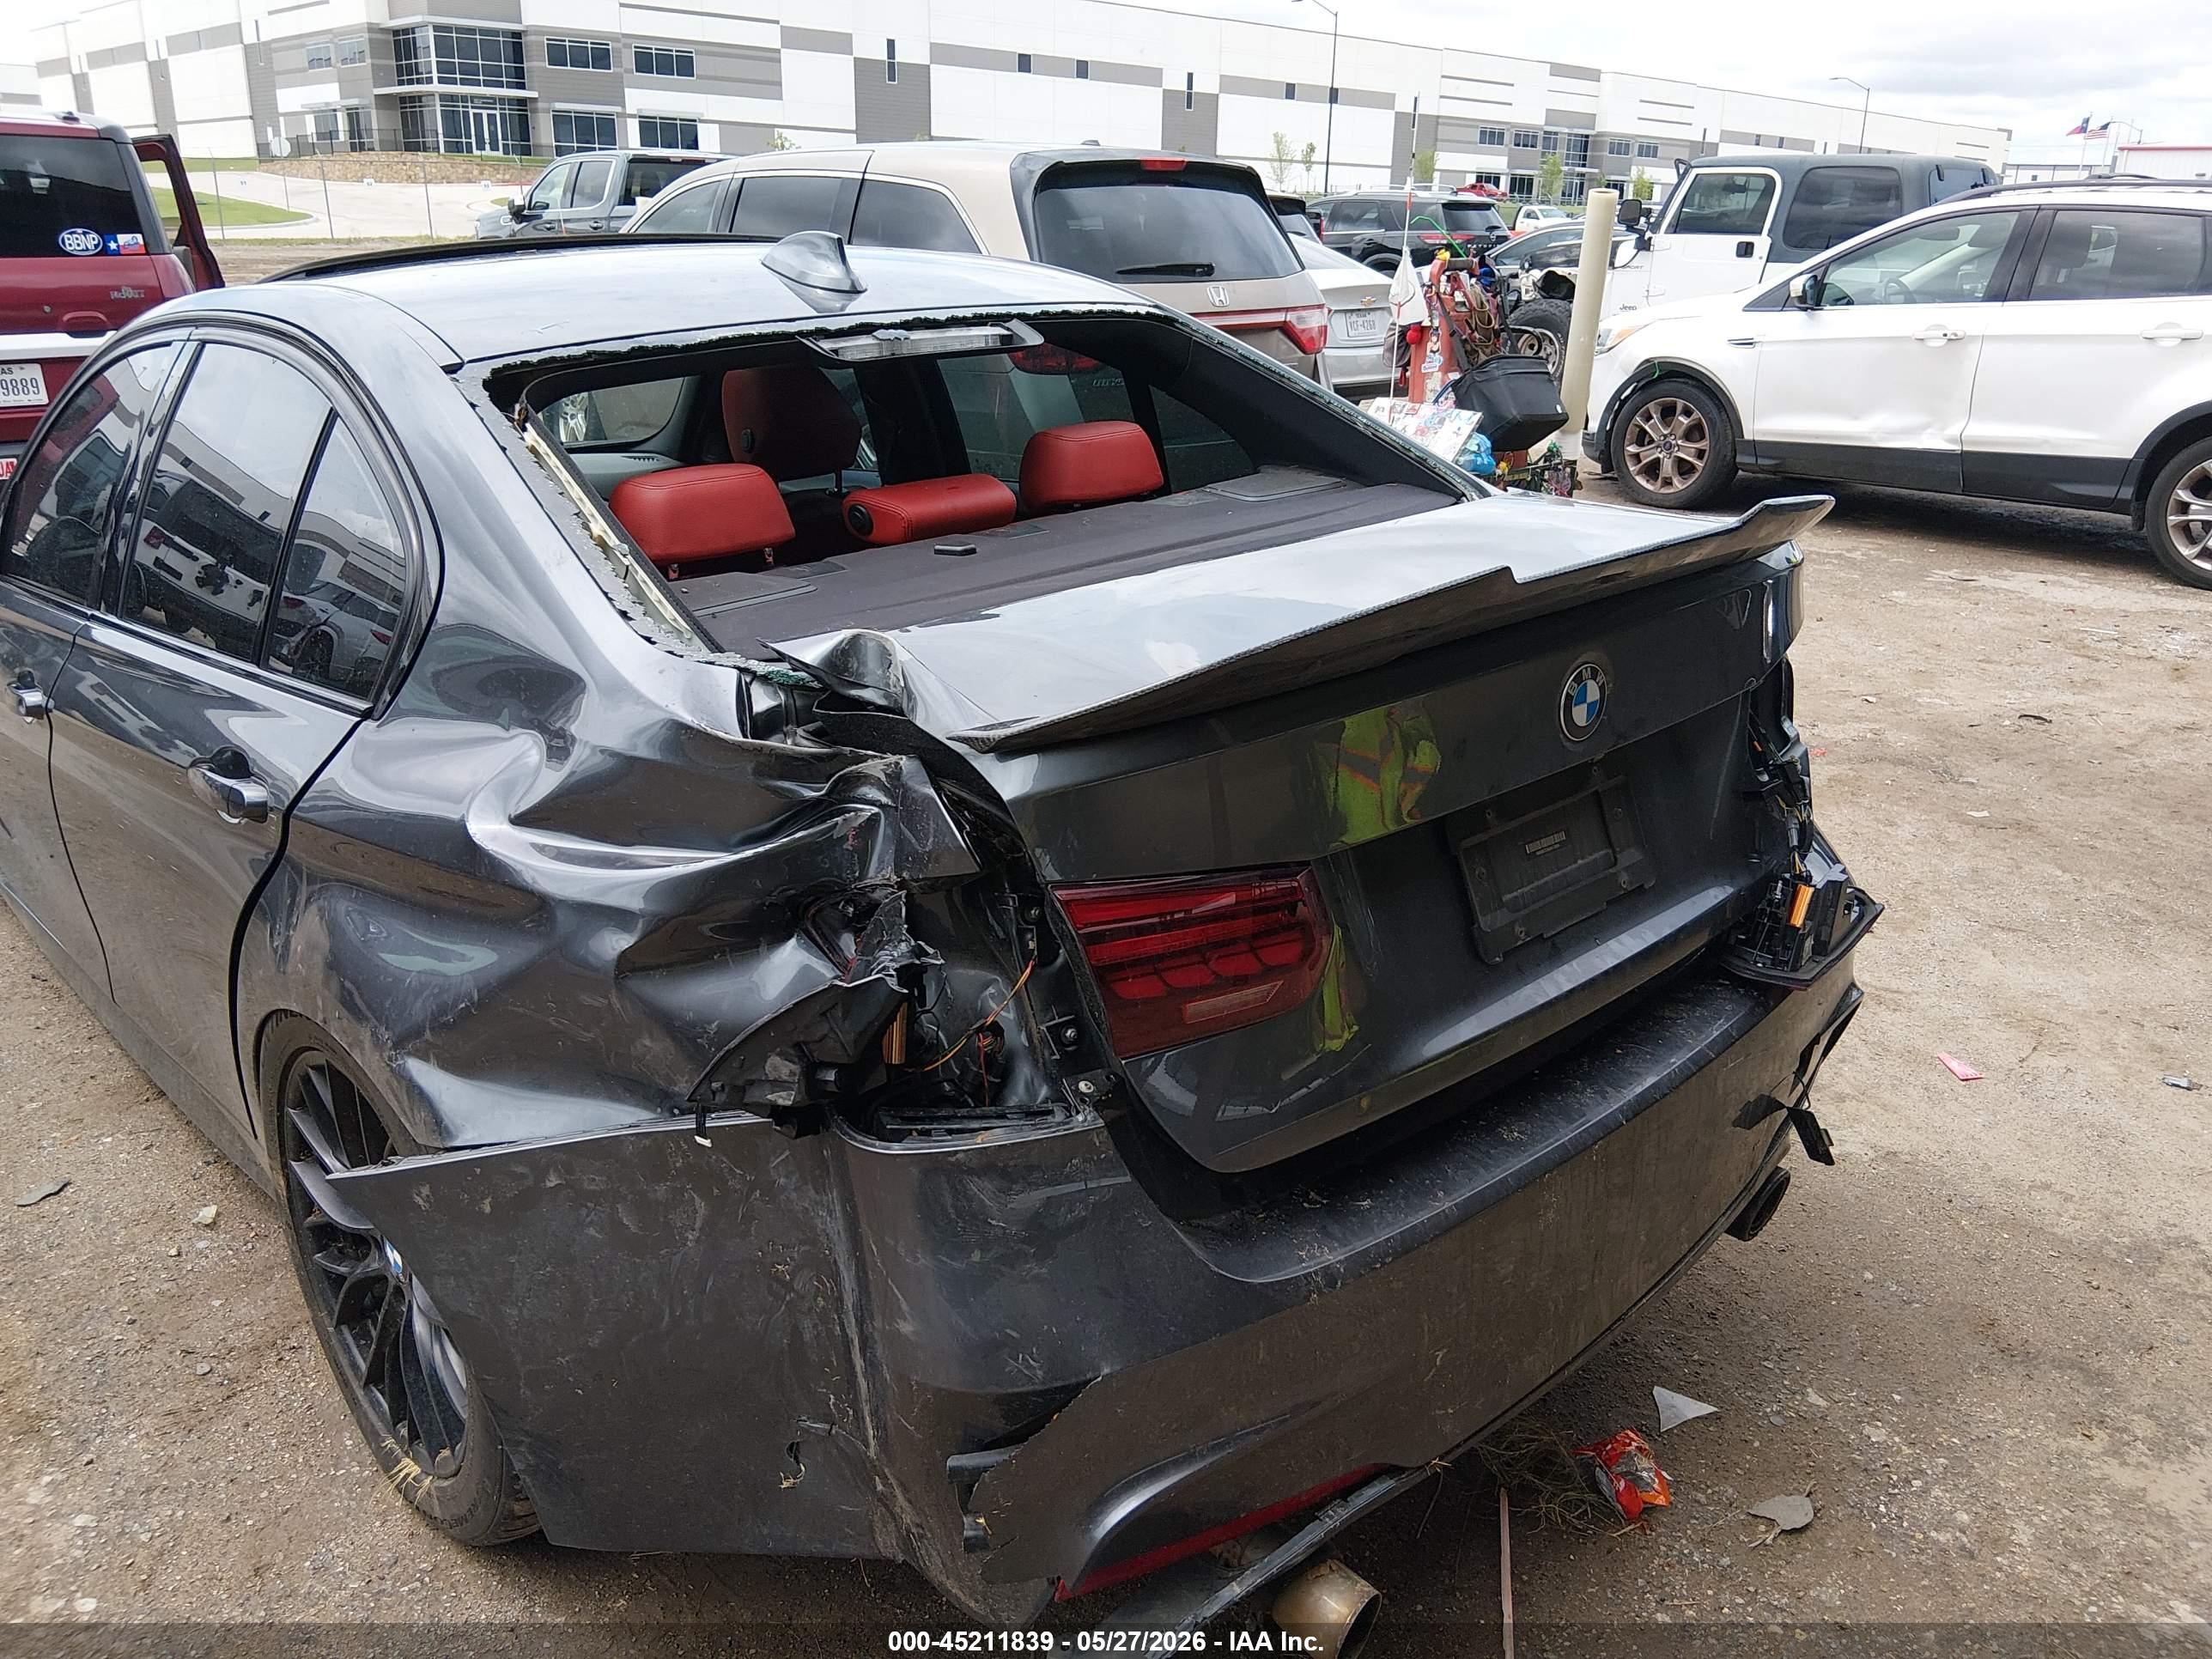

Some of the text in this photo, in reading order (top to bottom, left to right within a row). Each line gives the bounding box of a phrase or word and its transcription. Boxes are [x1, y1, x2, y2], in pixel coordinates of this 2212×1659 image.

[64, 234, 99, 250] BBNP
[0, 377, 40, 397] 9889
[1568, 666, 1605, 696] BMW
